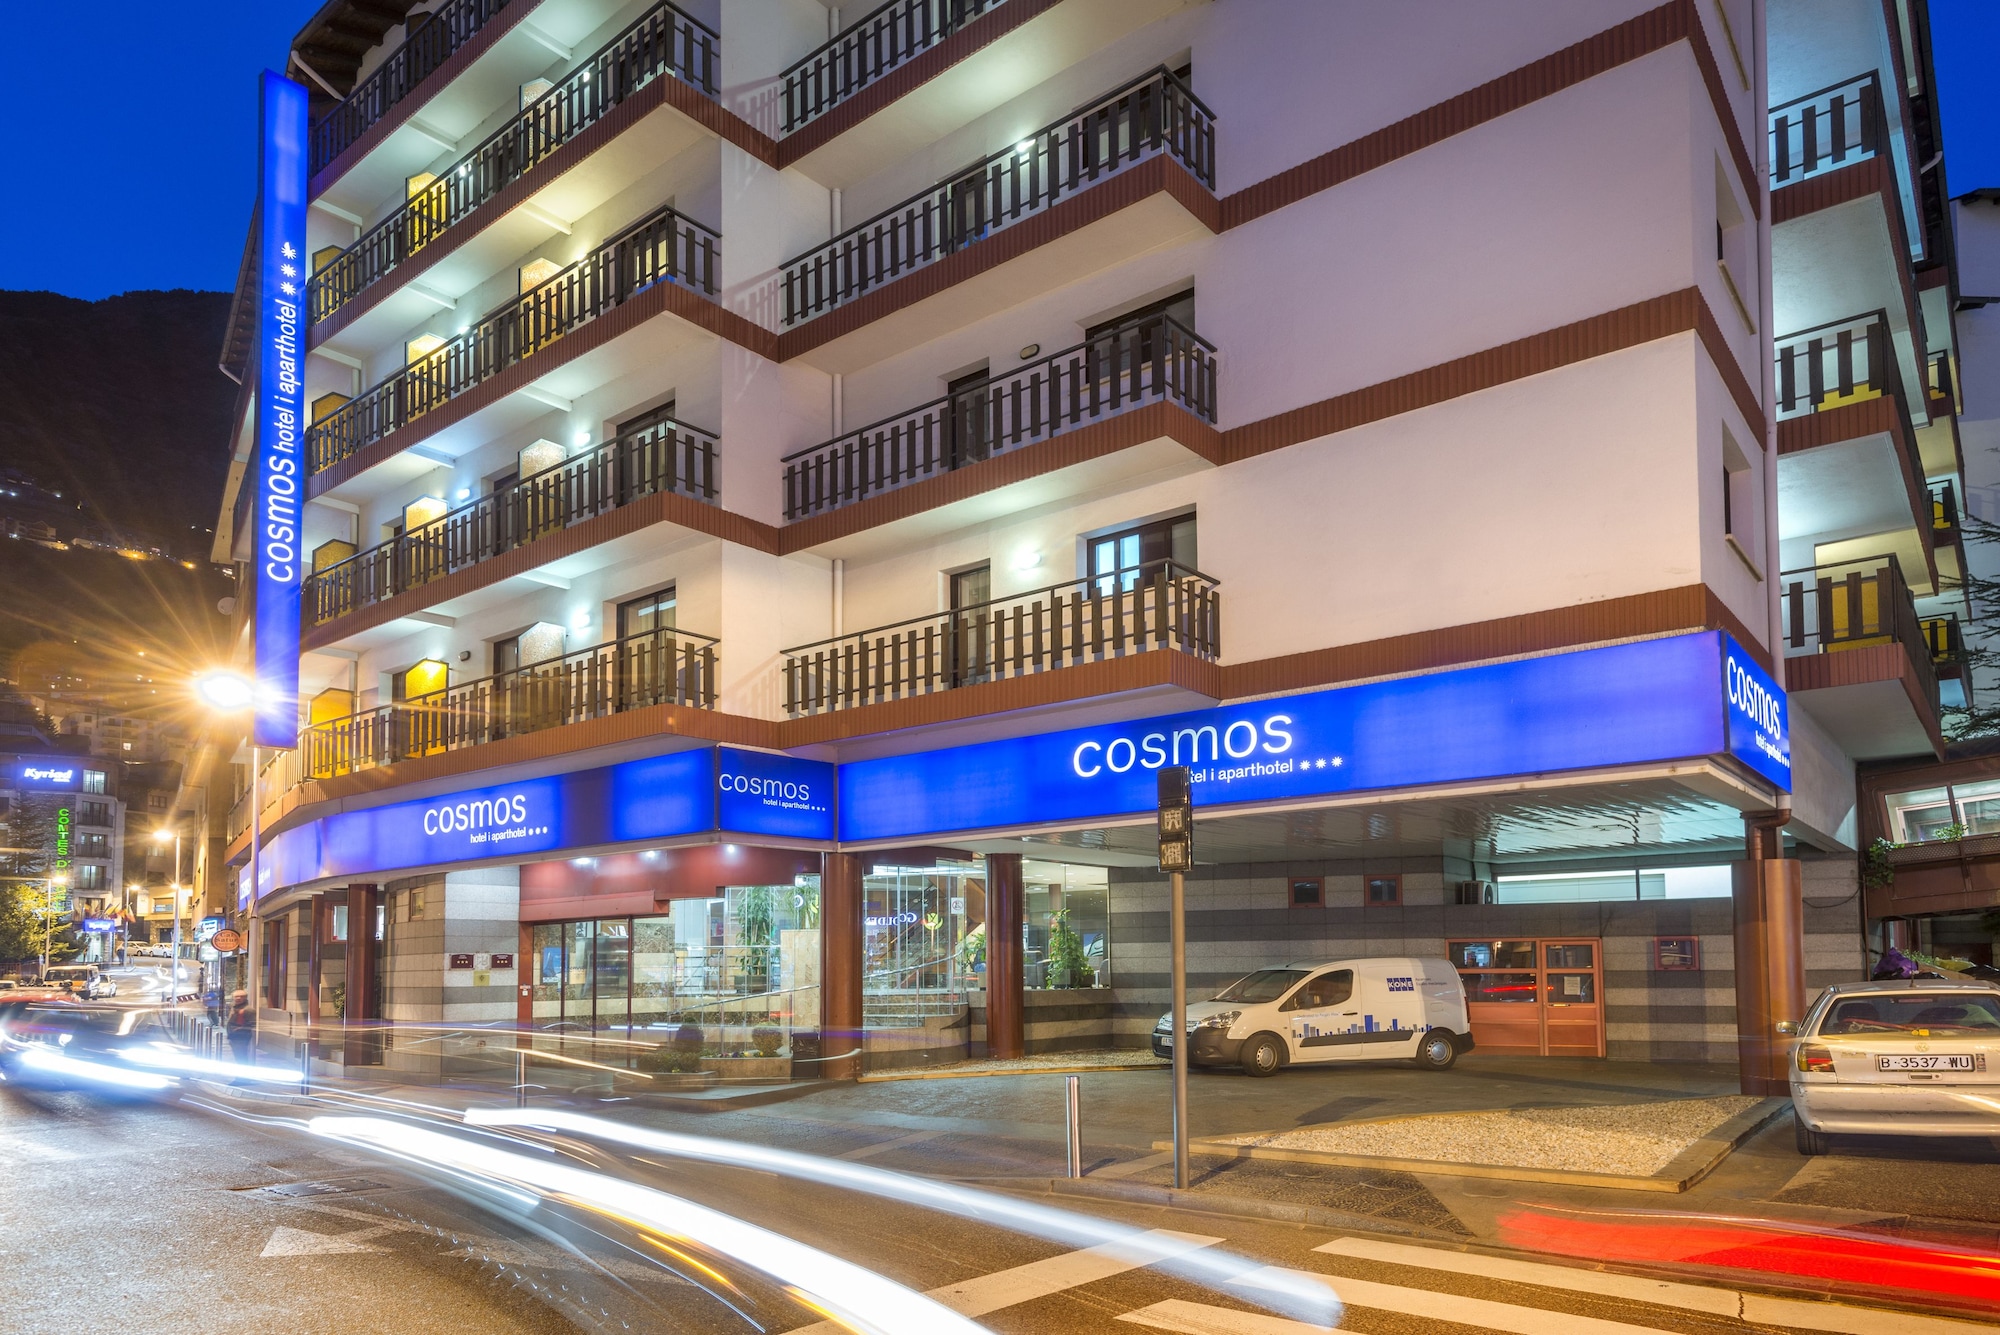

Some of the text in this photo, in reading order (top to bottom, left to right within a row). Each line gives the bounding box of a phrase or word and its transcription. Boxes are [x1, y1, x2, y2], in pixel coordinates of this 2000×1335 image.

[267, 298, 301, 583] cosmos hotel i aparthotel
[1727, 656, 1780, 740] cosmos
[1073, 715, 1293, 778] cosmos
[719, 774, 810, 801] cosmos
[1191, 759, 1293, 784] tel i aparthotel
[424, 794, 527, 836] cosmos
[763, 798, 778, 806] hotel
[781, 801, 810, 810] aparthotel
[470, 831, 487, 843] hotel
[491, 826, 527, 843] aparthotel
